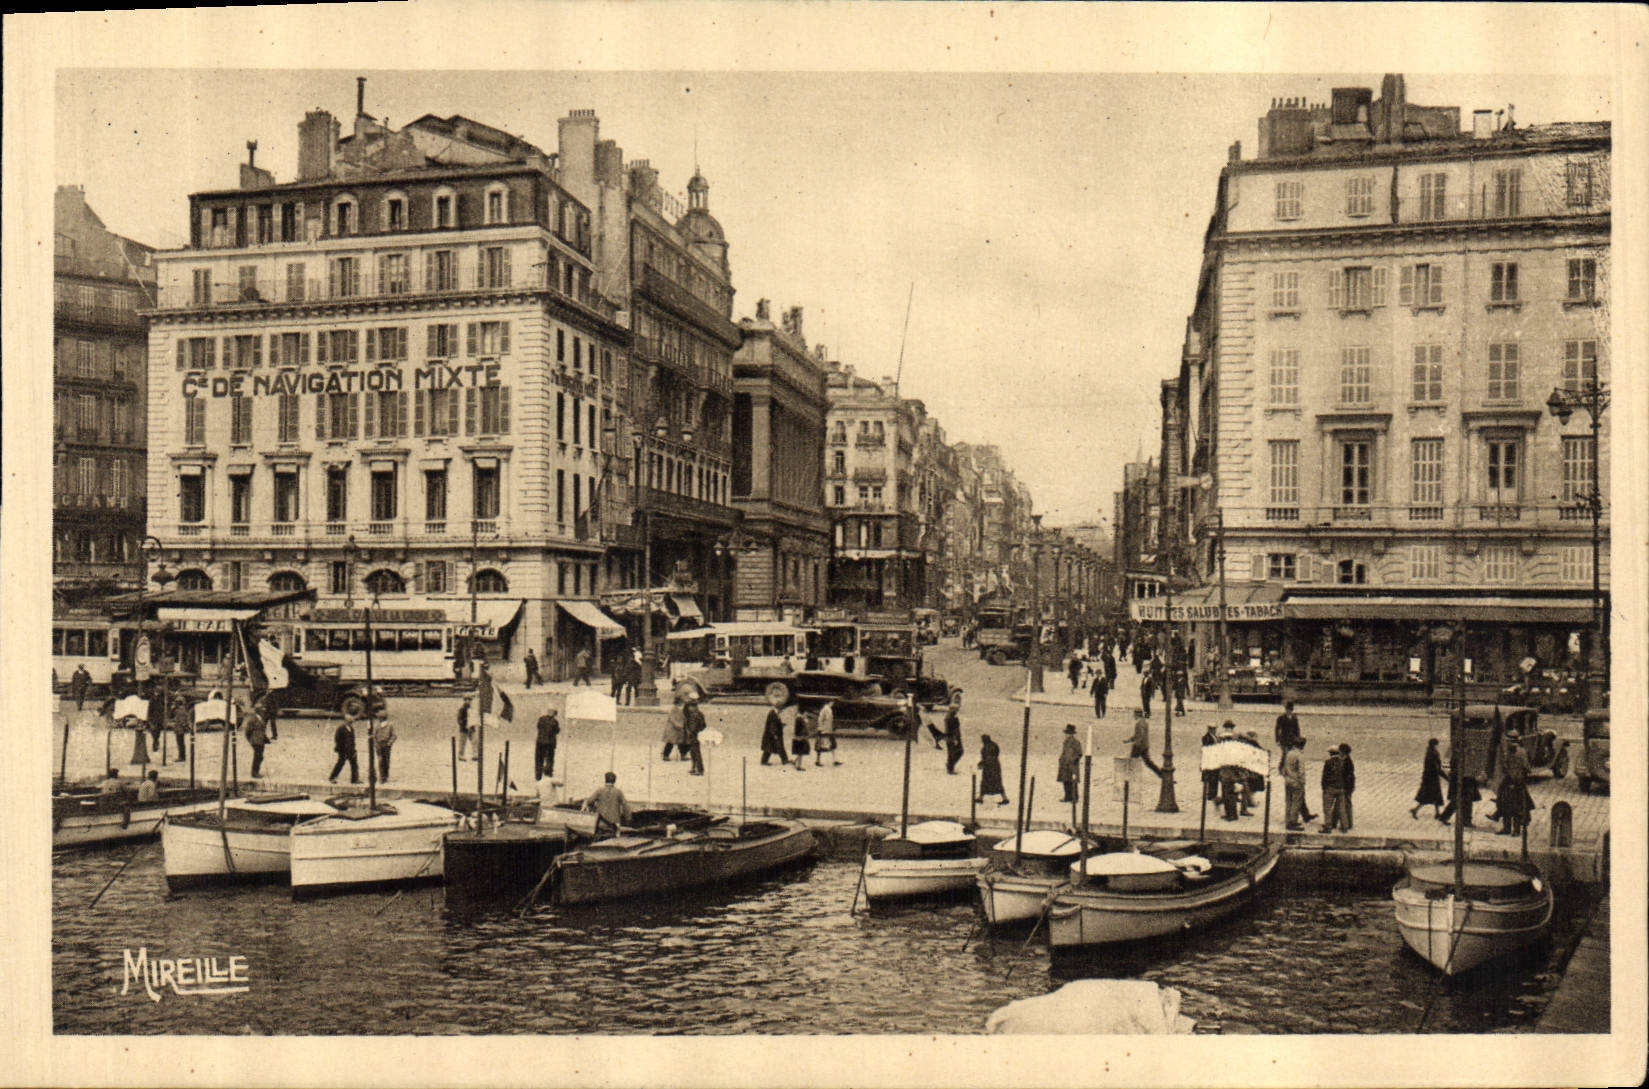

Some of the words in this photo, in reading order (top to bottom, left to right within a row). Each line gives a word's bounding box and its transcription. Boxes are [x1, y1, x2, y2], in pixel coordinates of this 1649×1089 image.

[213, 375, 244, 397] DE
[254, 370, 403, 396] NAVIGATION
[415, 365, 502, 389] MIXTE
[1139, 604, 1184, 619] HUITES
